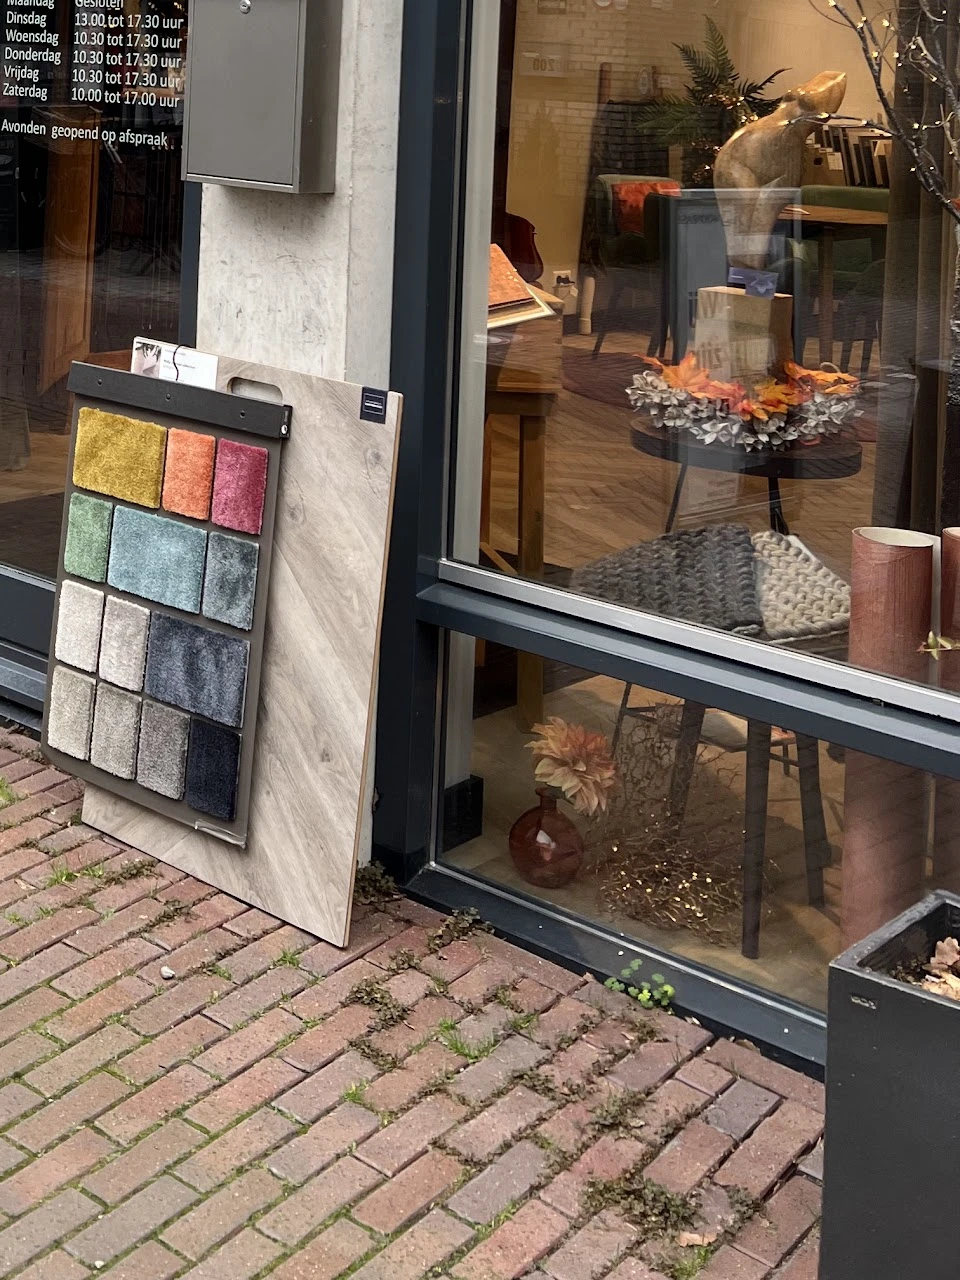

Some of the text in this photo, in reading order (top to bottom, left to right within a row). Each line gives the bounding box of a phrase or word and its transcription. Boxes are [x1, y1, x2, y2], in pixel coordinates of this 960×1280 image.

[6, 10, 185, 30] Dinsdag 13.00 tot 17.30 uur
[5, 28, 183, 49] Woensdag 10.30 tot 17.30 uur
[4, 46, 182, 68] Donderdag 10.30 tot 17.30 uur
[3, 64, 182, 88] Vrijdag 10.30 tot 17.30 uur
[2, 82, 180, 108] Zaterdag 10.00 tot 17.00 uur
[0, 118, 168, 147] Avonden geopend op afspraak
